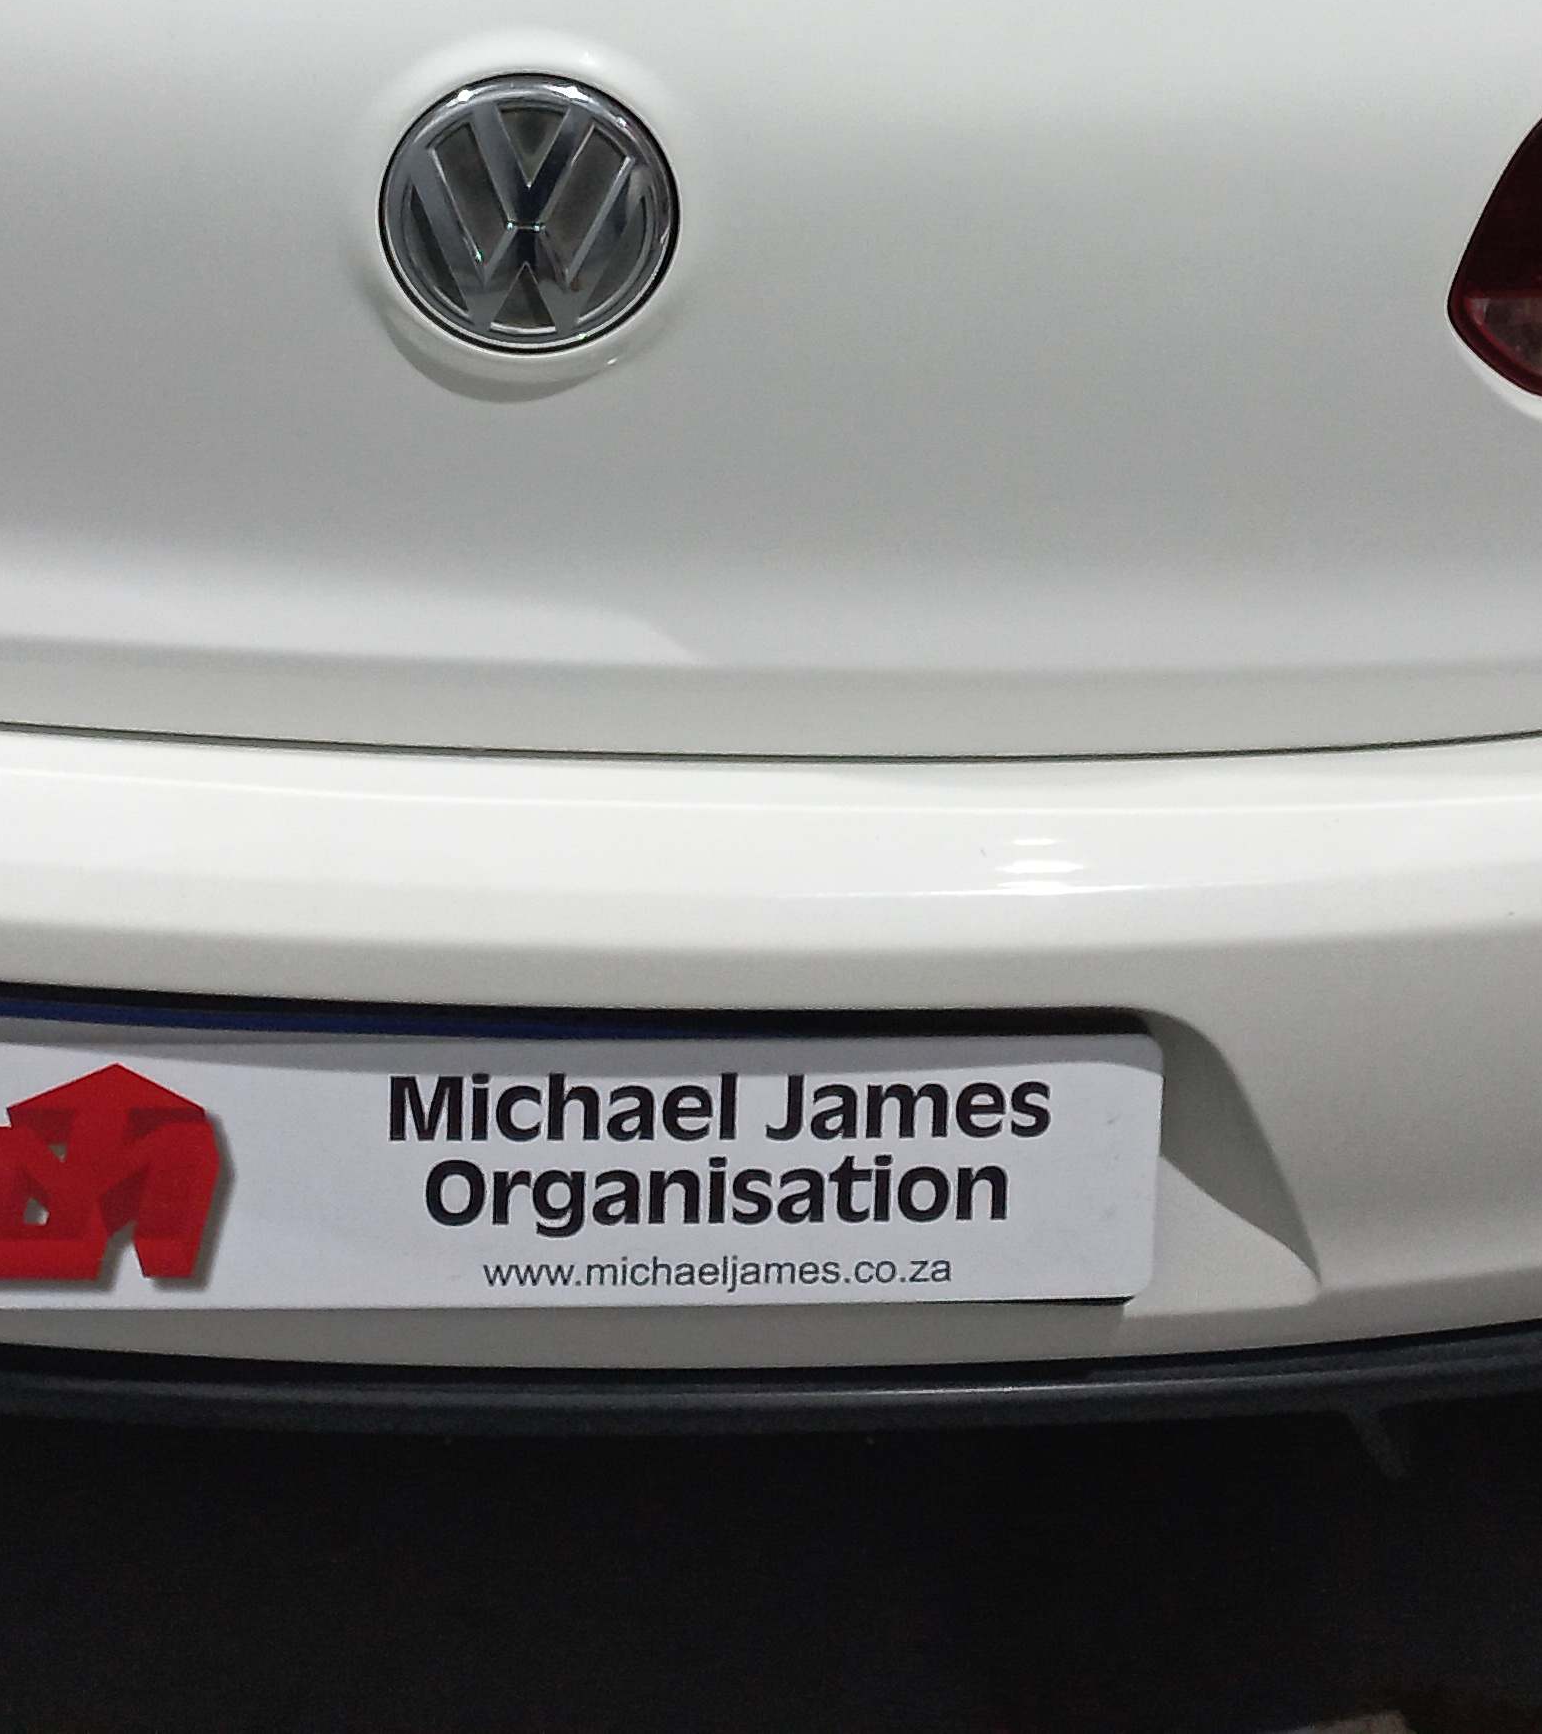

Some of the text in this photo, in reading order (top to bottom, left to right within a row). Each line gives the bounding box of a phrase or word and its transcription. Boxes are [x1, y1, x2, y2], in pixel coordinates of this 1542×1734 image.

[388, 1072, 1052, 1142] Michael James
[425, 1154, 1009, 1238] Organisation
[483, 1254, 952, 1293] www.michaeljames.co.za
